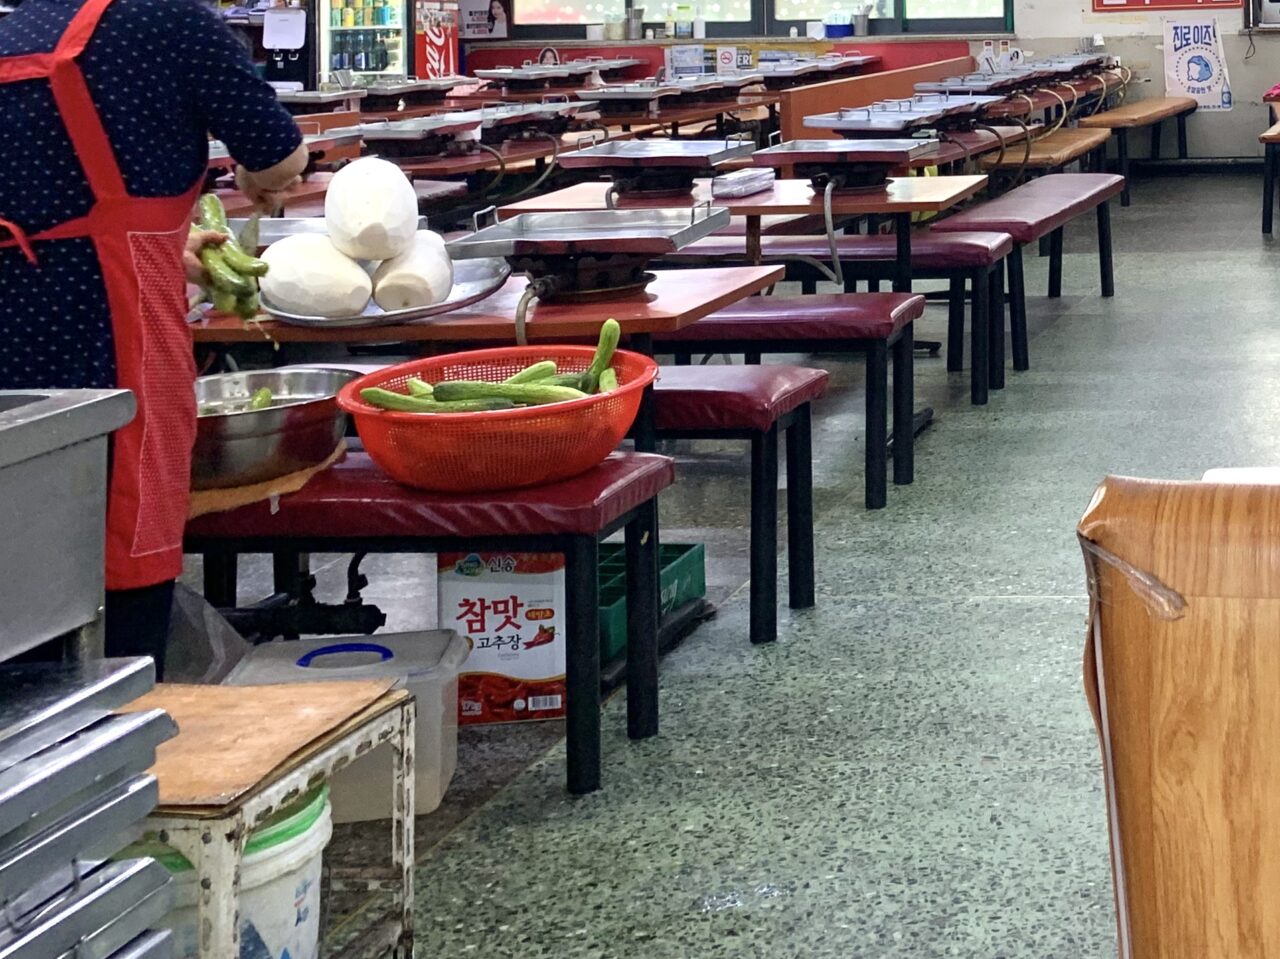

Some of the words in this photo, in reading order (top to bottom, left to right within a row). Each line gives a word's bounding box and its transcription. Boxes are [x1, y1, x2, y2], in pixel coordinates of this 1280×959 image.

[488, 556, 516, 573] 신송
[456, 595, 524, 634] 참맛
[476, 634, 522, 650] 고추장
